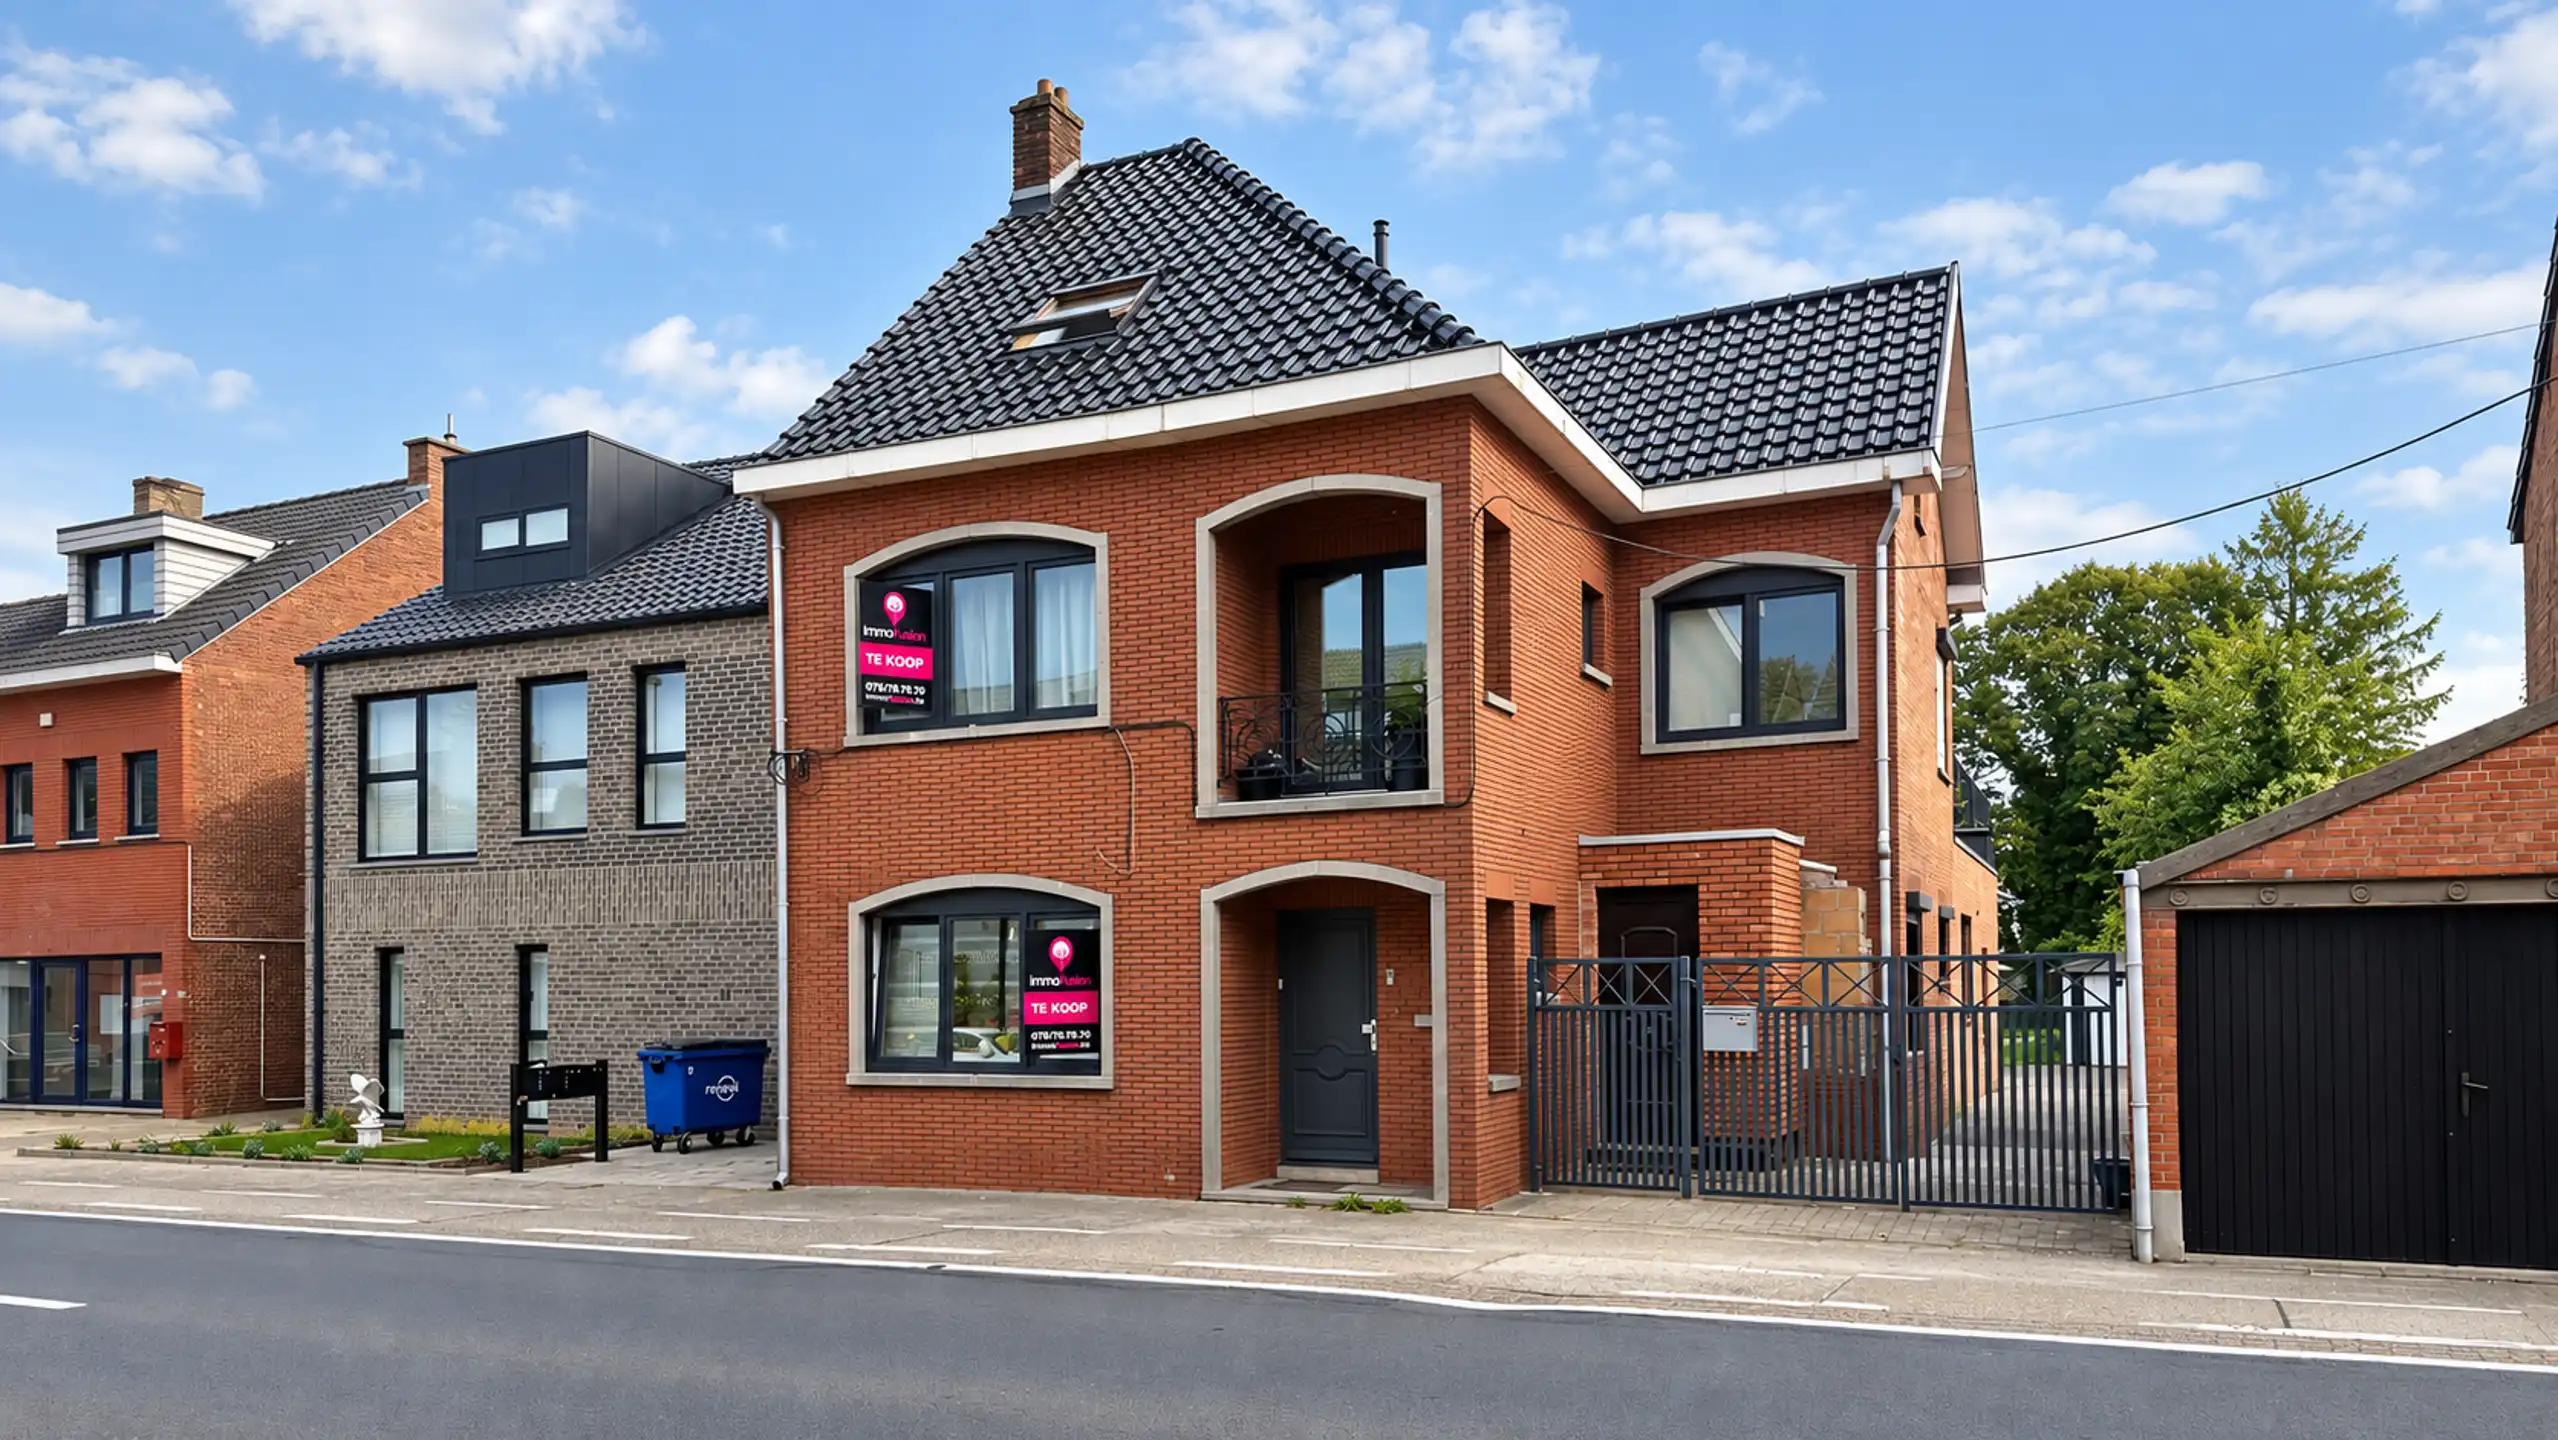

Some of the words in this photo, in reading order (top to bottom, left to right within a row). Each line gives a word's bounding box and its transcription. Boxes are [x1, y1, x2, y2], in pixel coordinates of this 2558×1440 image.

[865, 653, 882, 665] TE
[885, 654, 924, 670] KOOP
[1031, 1002, 1047, 1014] TE
[1051, 1002, 1088, 1014] KOOP
